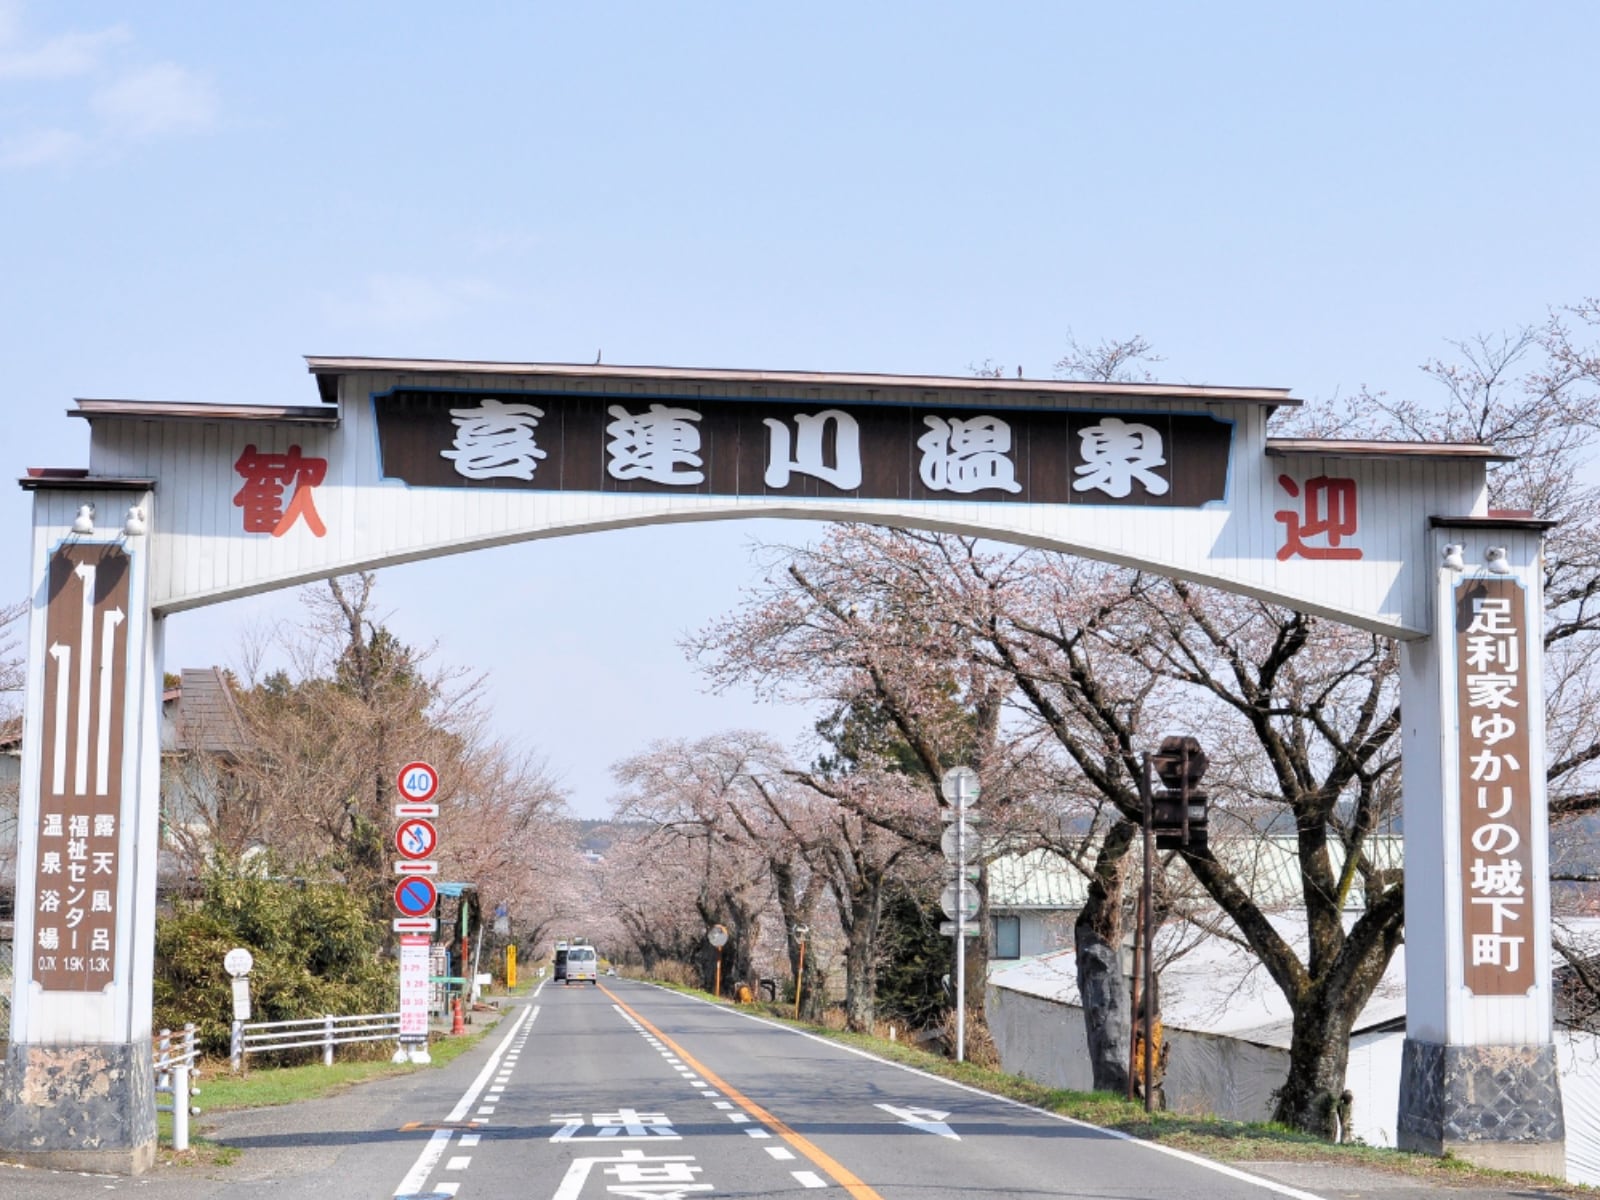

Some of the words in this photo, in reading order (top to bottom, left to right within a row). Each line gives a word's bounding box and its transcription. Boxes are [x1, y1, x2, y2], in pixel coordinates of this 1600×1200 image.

[440, 399, 1169, 498] 喜連川温泉
[1274, 474, 1363, 562] 迎
[406, 773, 429, 791] 40
[1466, 598, 1525, 972] 足利家ゆかりの城下町
[38, 814, 63, 949] 温泉浴場
[65, 815, 89, 949] 福祉センター
[91, 814, 115, 951] 露天風呂
